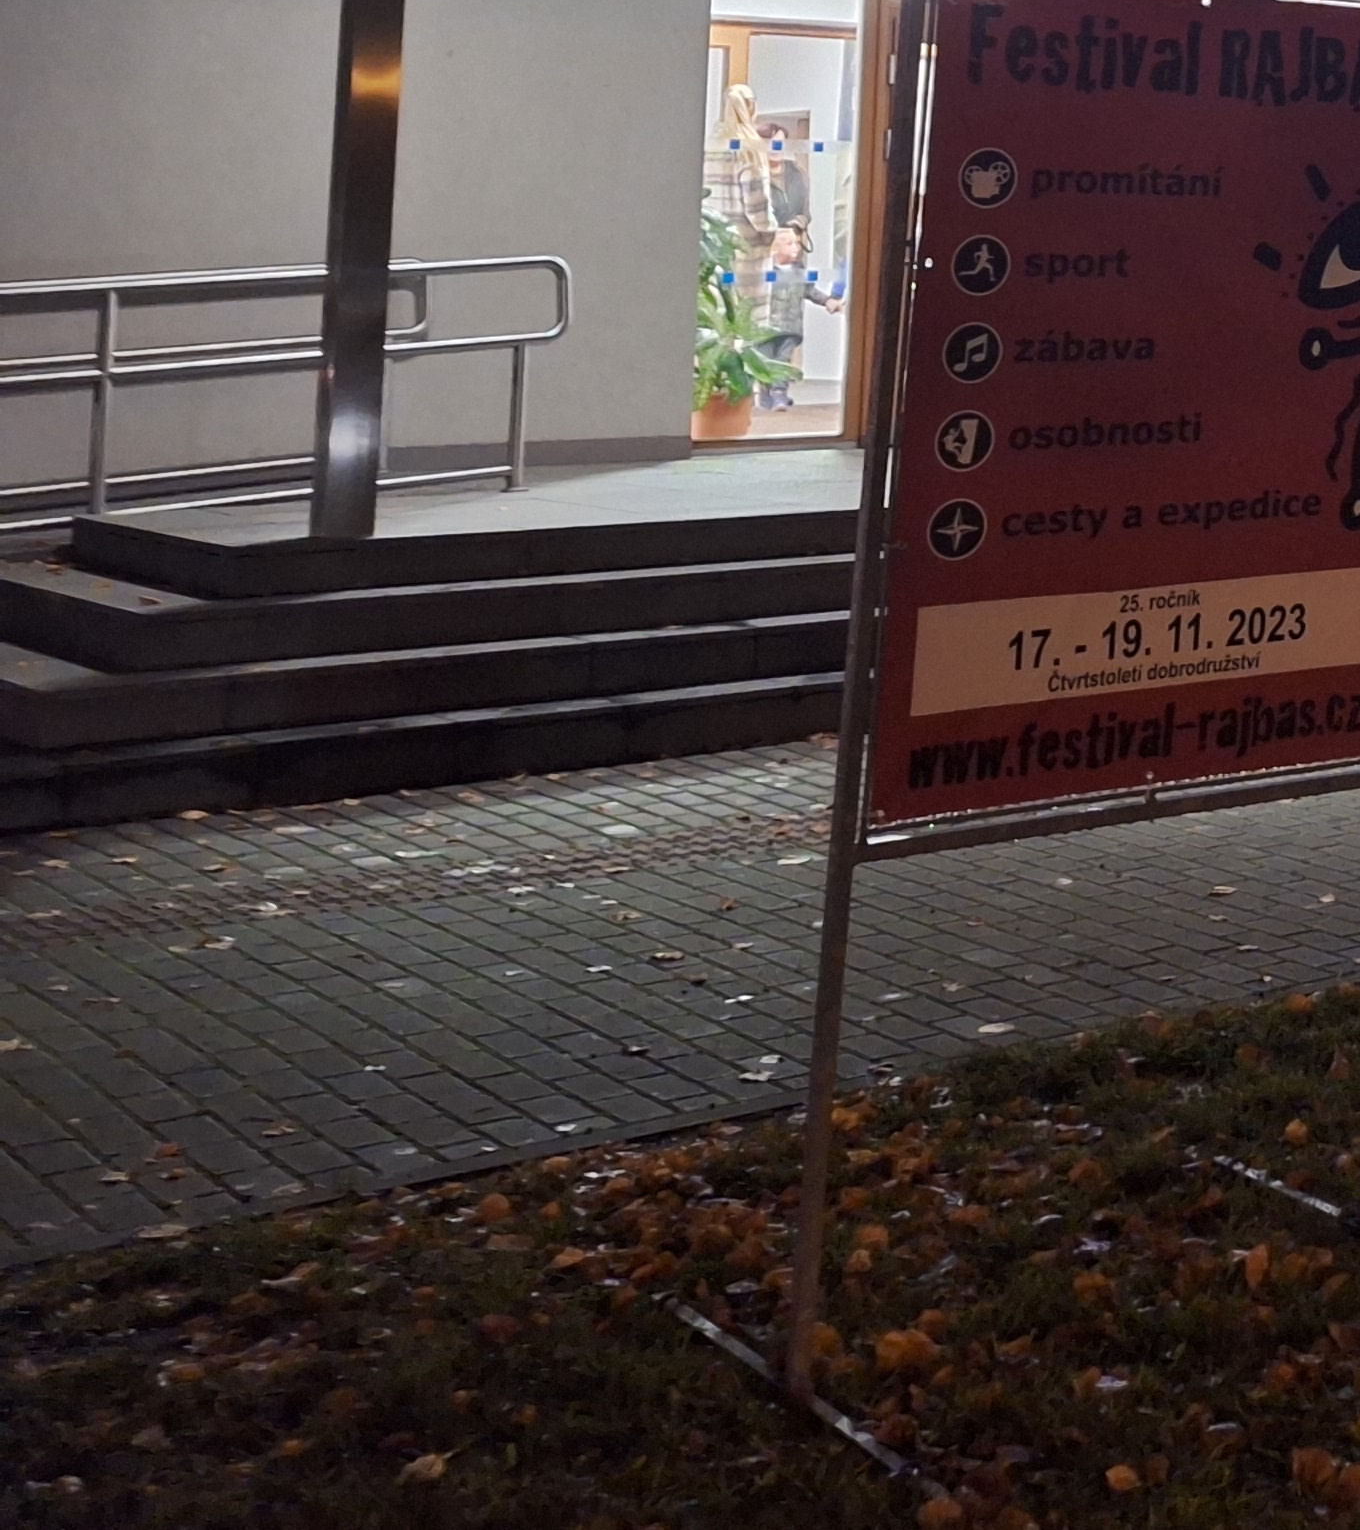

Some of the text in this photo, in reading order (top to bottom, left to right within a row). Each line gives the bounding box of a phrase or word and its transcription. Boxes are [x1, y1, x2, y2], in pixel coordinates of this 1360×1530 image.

[967, 2, 1203, 96] Festival
[1031, 163, 1225, 198] promítání
[1025, 249, 1130, 283] sport
[1014, 330, 1155, 362] zábava
[1008, 412, 1202, 450] osobnosti
[1002, 489, 1322, 538] cesty a expedice
[1119, 589, 1200, 613] 25. ročník
[1008, 628, 1061, 670] 17.
[1102, 619, 1151, 660] 19.
[1168, 612, 1213, 653] 11.
[1226, 603, 1307, 647] 2023
[1147, 651, 1262, 681] dobrodružství
